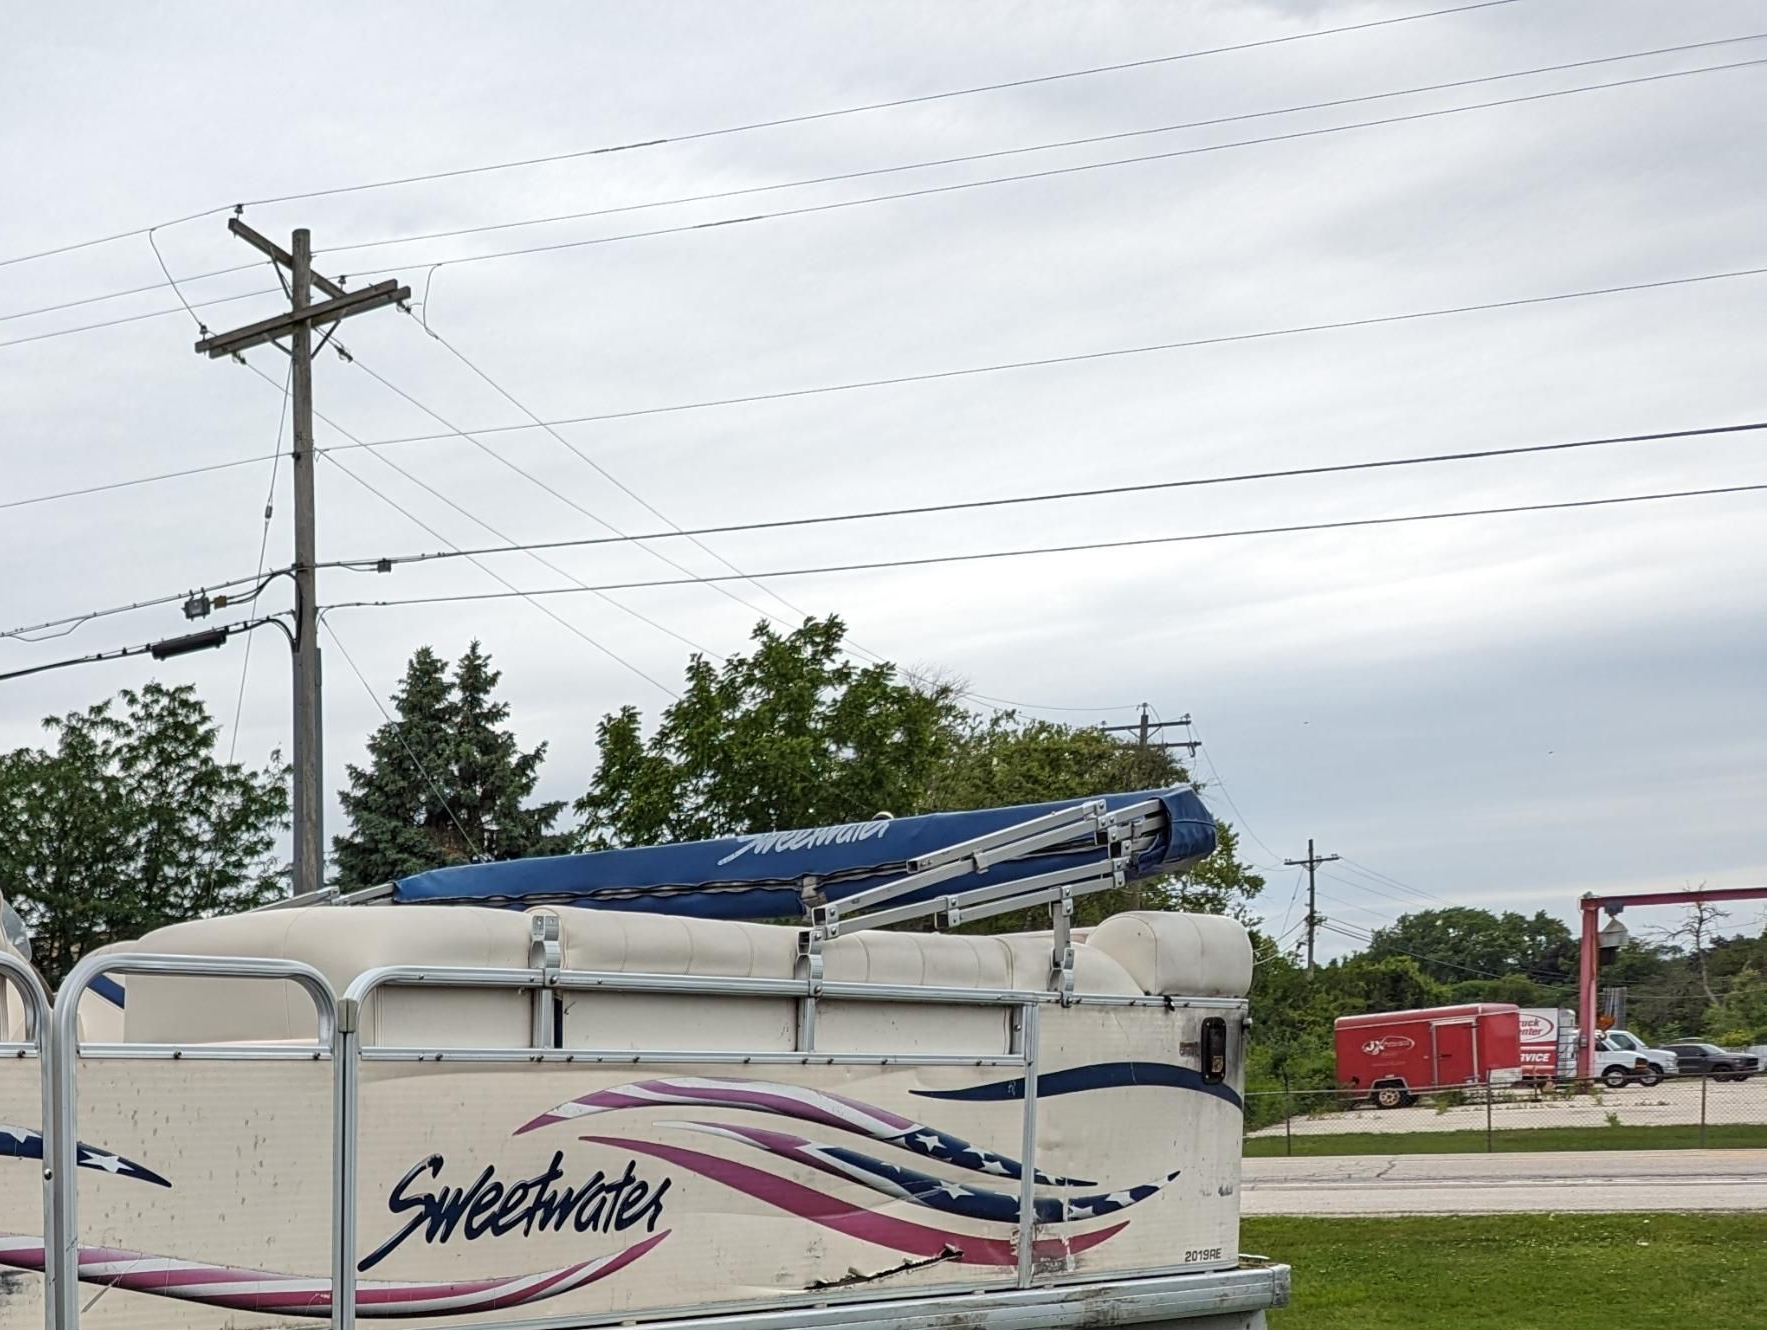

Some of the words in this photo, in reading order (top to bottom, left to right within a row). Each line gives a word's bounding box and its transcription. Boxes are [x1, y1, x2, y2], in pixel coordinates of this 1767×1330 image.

[1520, 1018, 1541, 1027] uck
[1520, 1027, 1543, 1036] nter
[357, 1150, 672, 1272] Sweetwater
